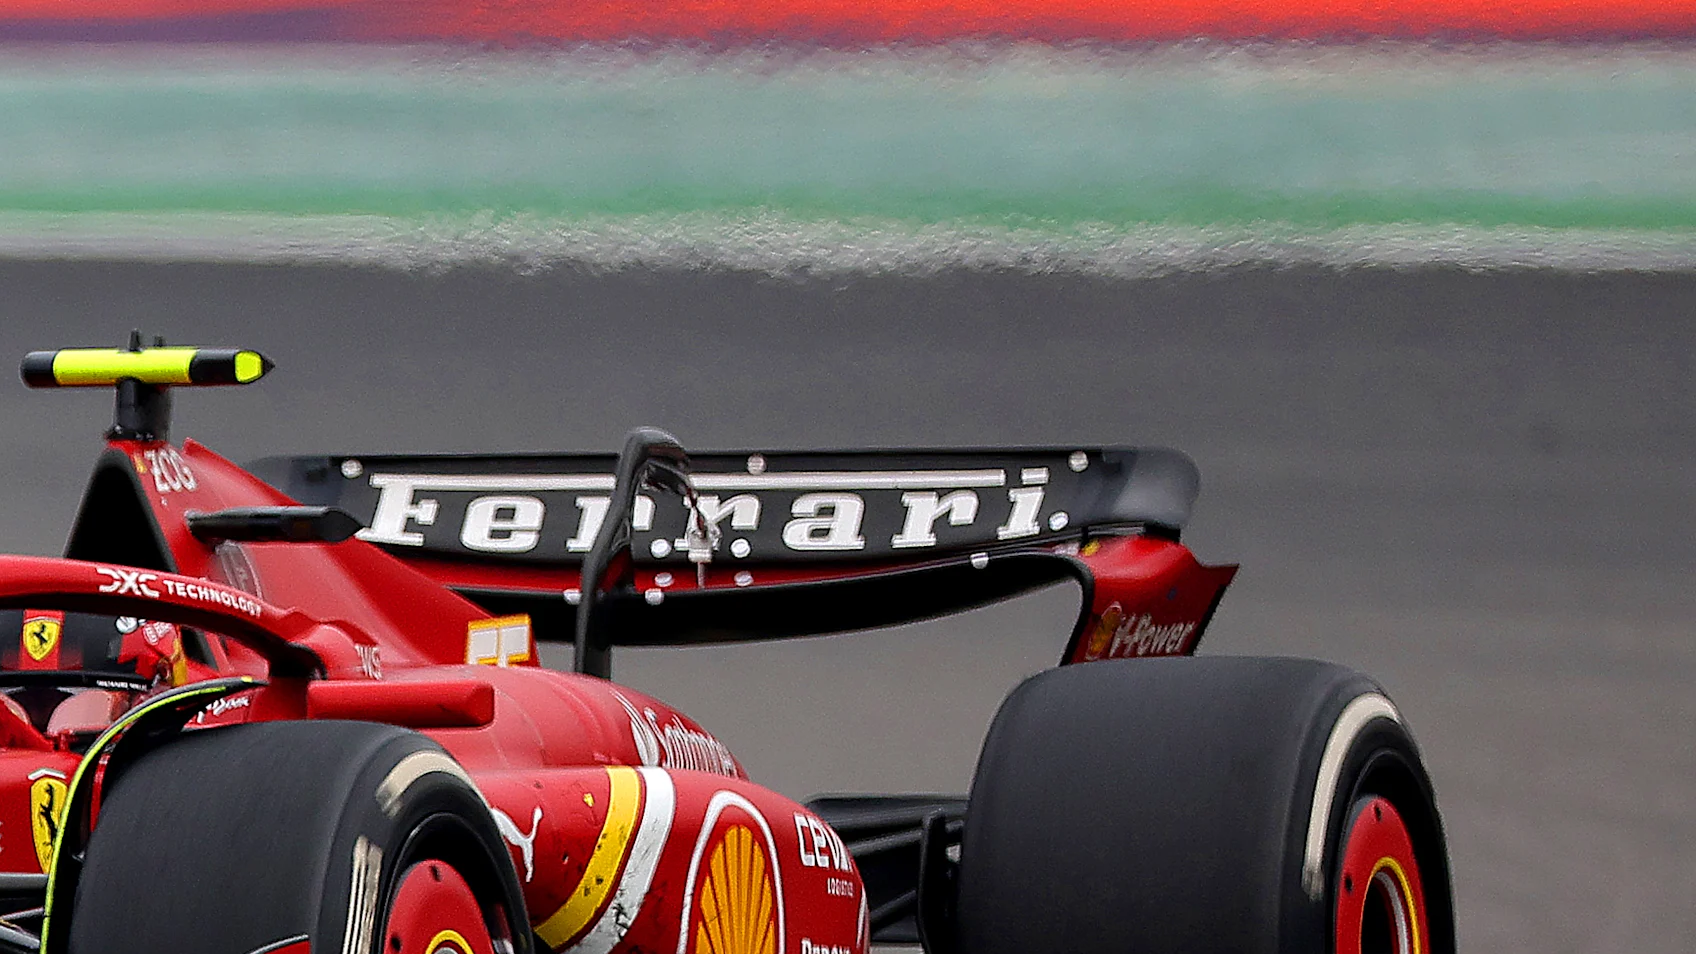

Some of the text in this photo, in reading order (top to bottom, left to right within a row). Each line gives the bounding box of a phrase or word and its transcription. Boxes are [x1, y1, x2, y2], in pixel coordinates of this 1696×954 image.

[354, 467, 1050, 553] Ferrari
[96, 567, 262, 618] DXC TECHNOLOGY
